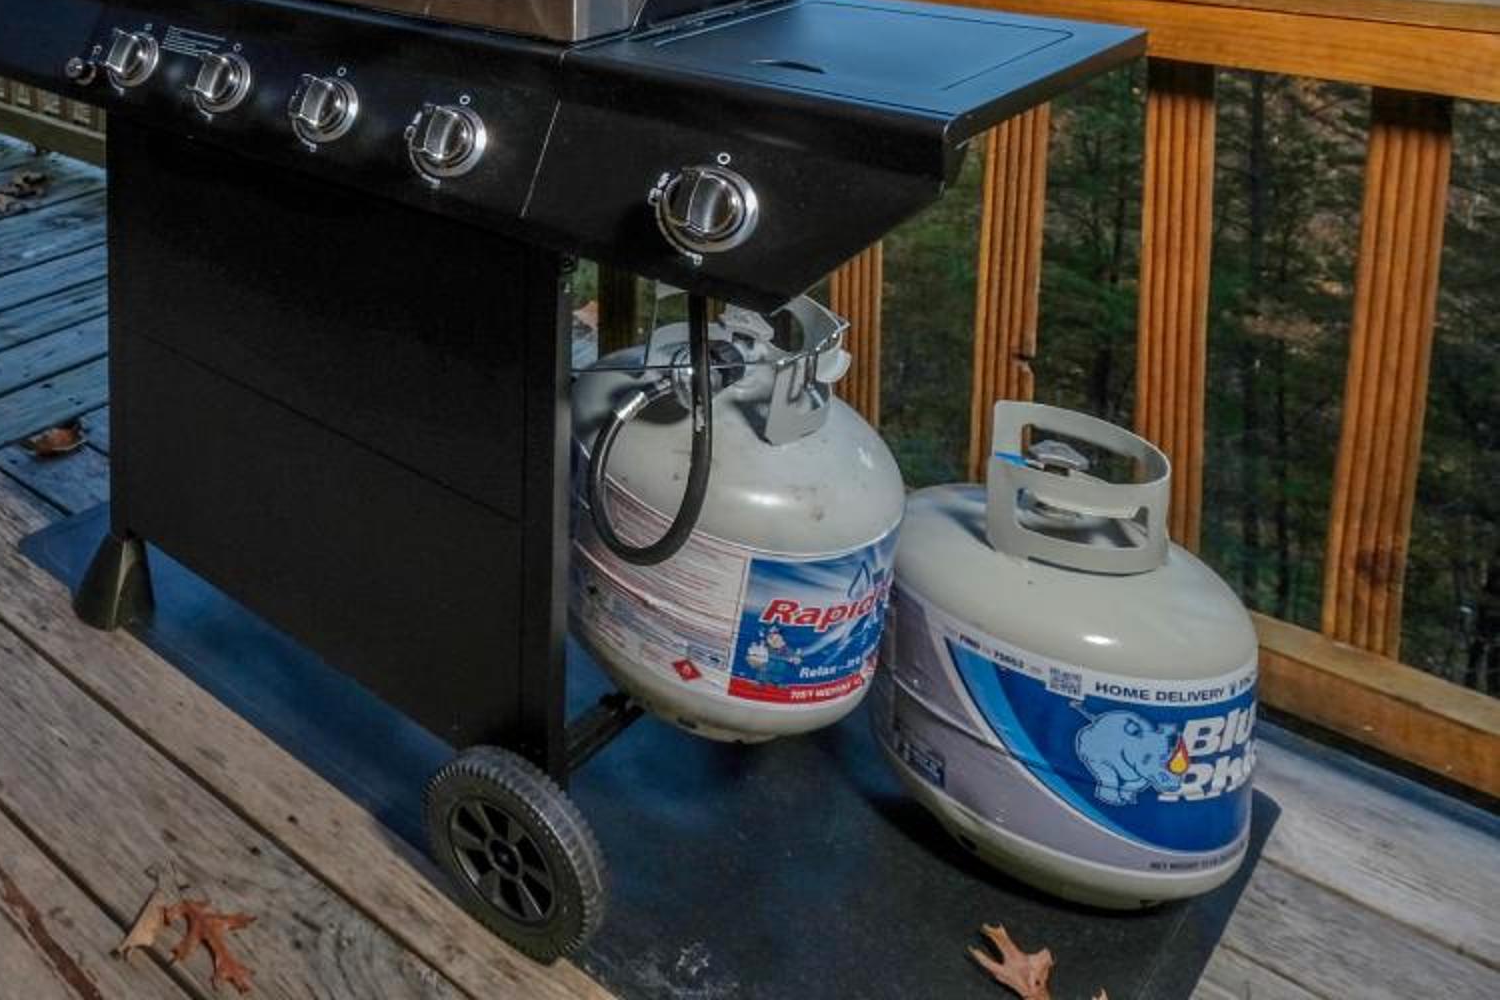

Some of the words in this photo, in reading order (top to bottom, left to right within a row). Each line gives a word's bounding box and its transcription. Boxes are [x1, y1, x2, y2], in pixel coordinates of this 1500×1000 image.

[1095, 681, 1149, 701] HOME
[1155, 687, 1225, 703] DELIVERY
[1183, 704, 1257, 757] Blu
